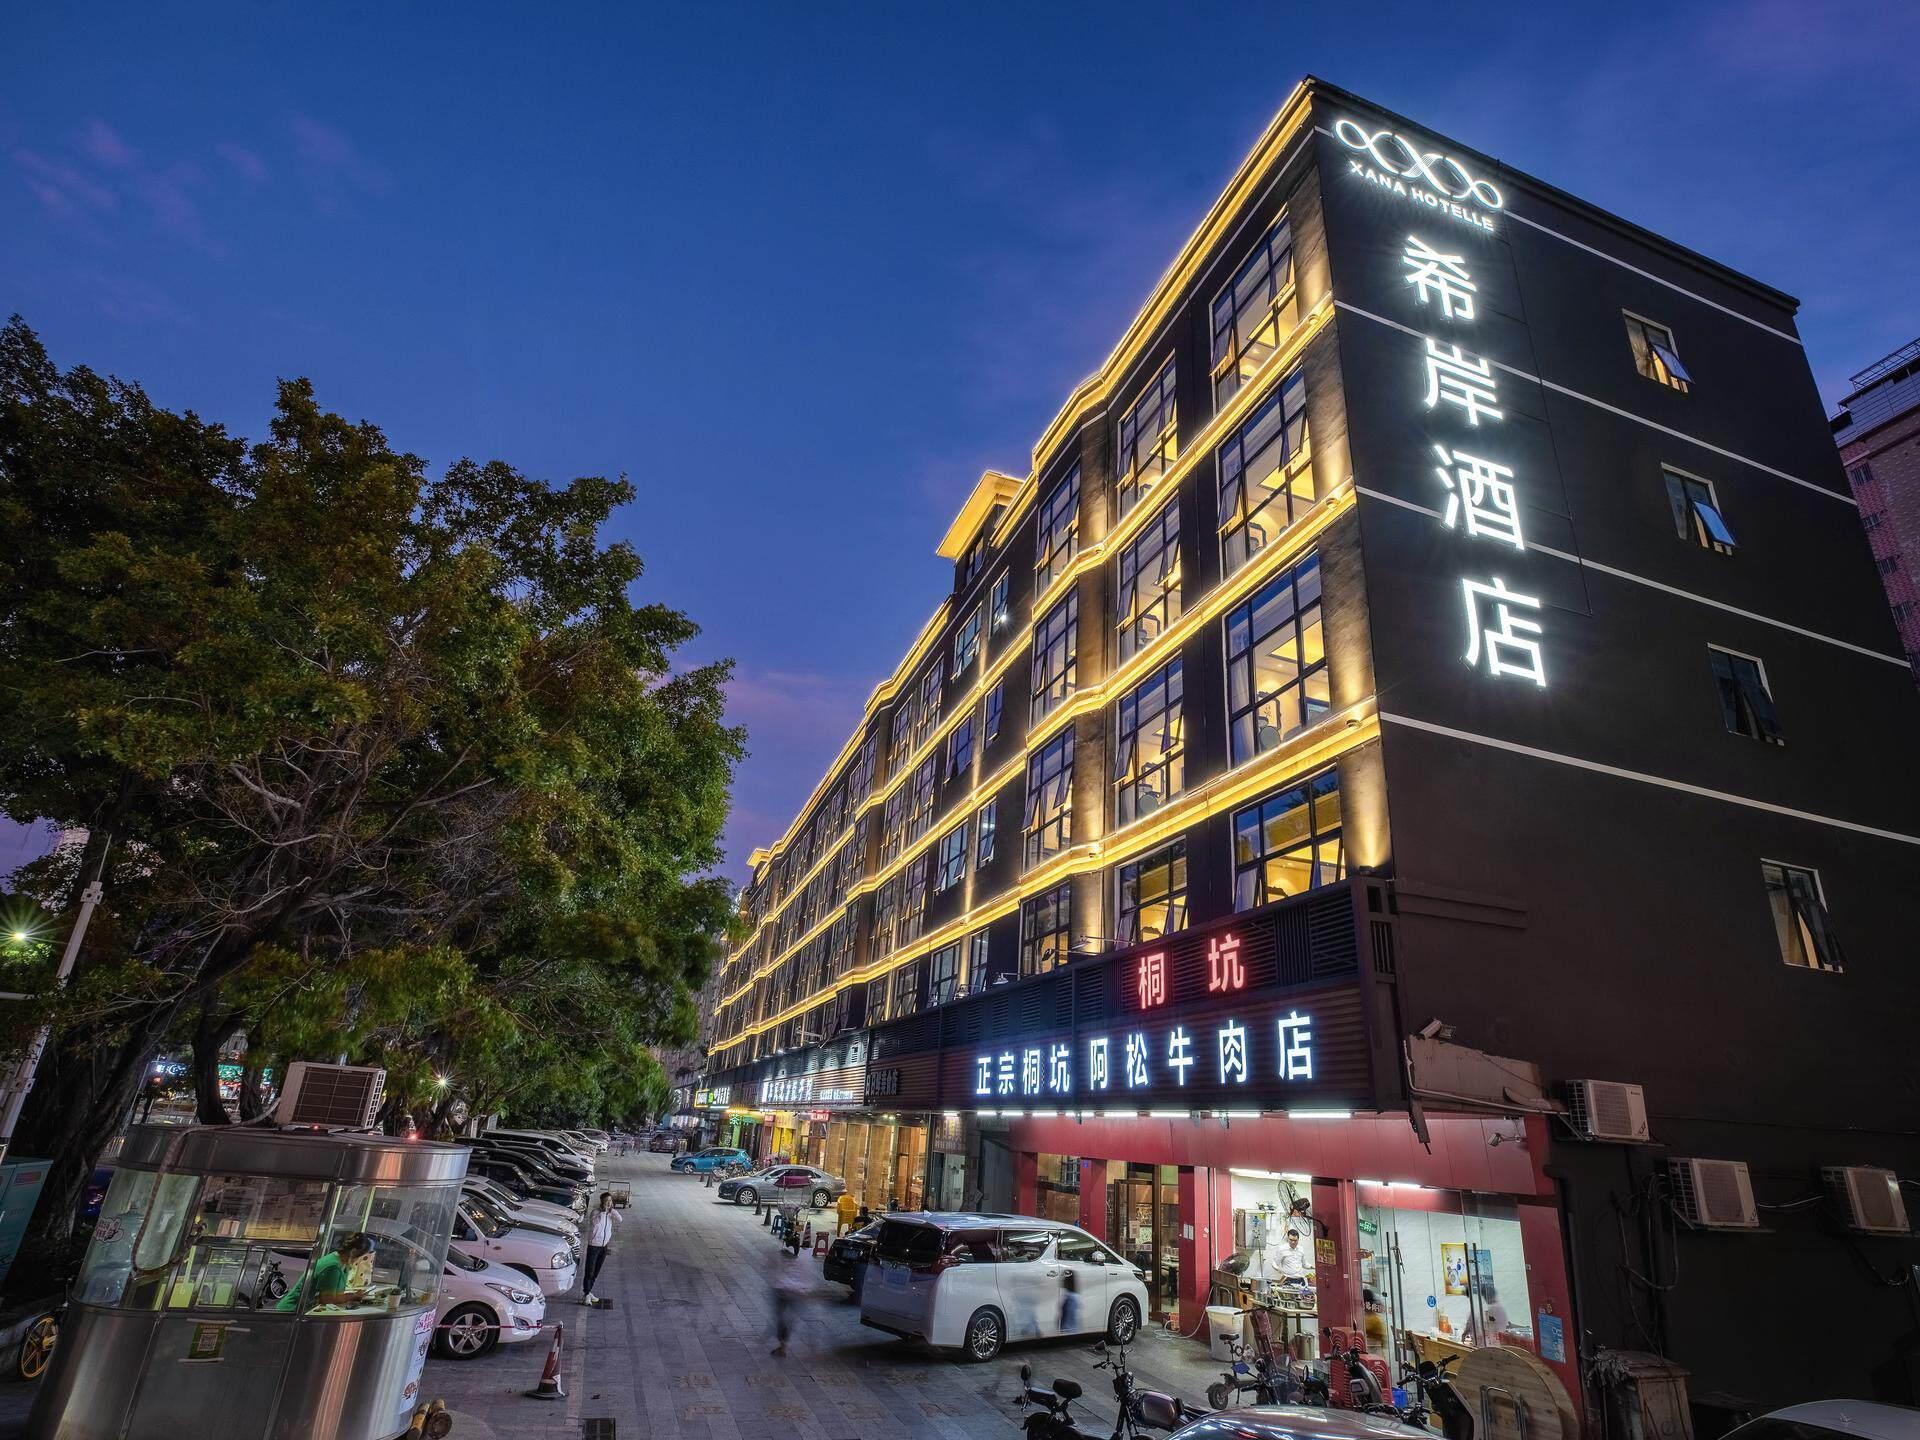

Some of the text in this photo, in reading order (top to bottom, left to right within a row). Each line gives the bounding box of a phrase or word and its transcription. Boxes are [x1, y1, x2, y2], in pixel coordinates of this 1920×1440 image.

[1350, 160, 1494, 232] XANA HOTELLE
[1403, 235, 1547, 687] 希岸酒店
[1138, 934, 1244, 1009] 桐坑
[976, 1011, 1313, 1095] 正宗桐坑阿松牛肉店
